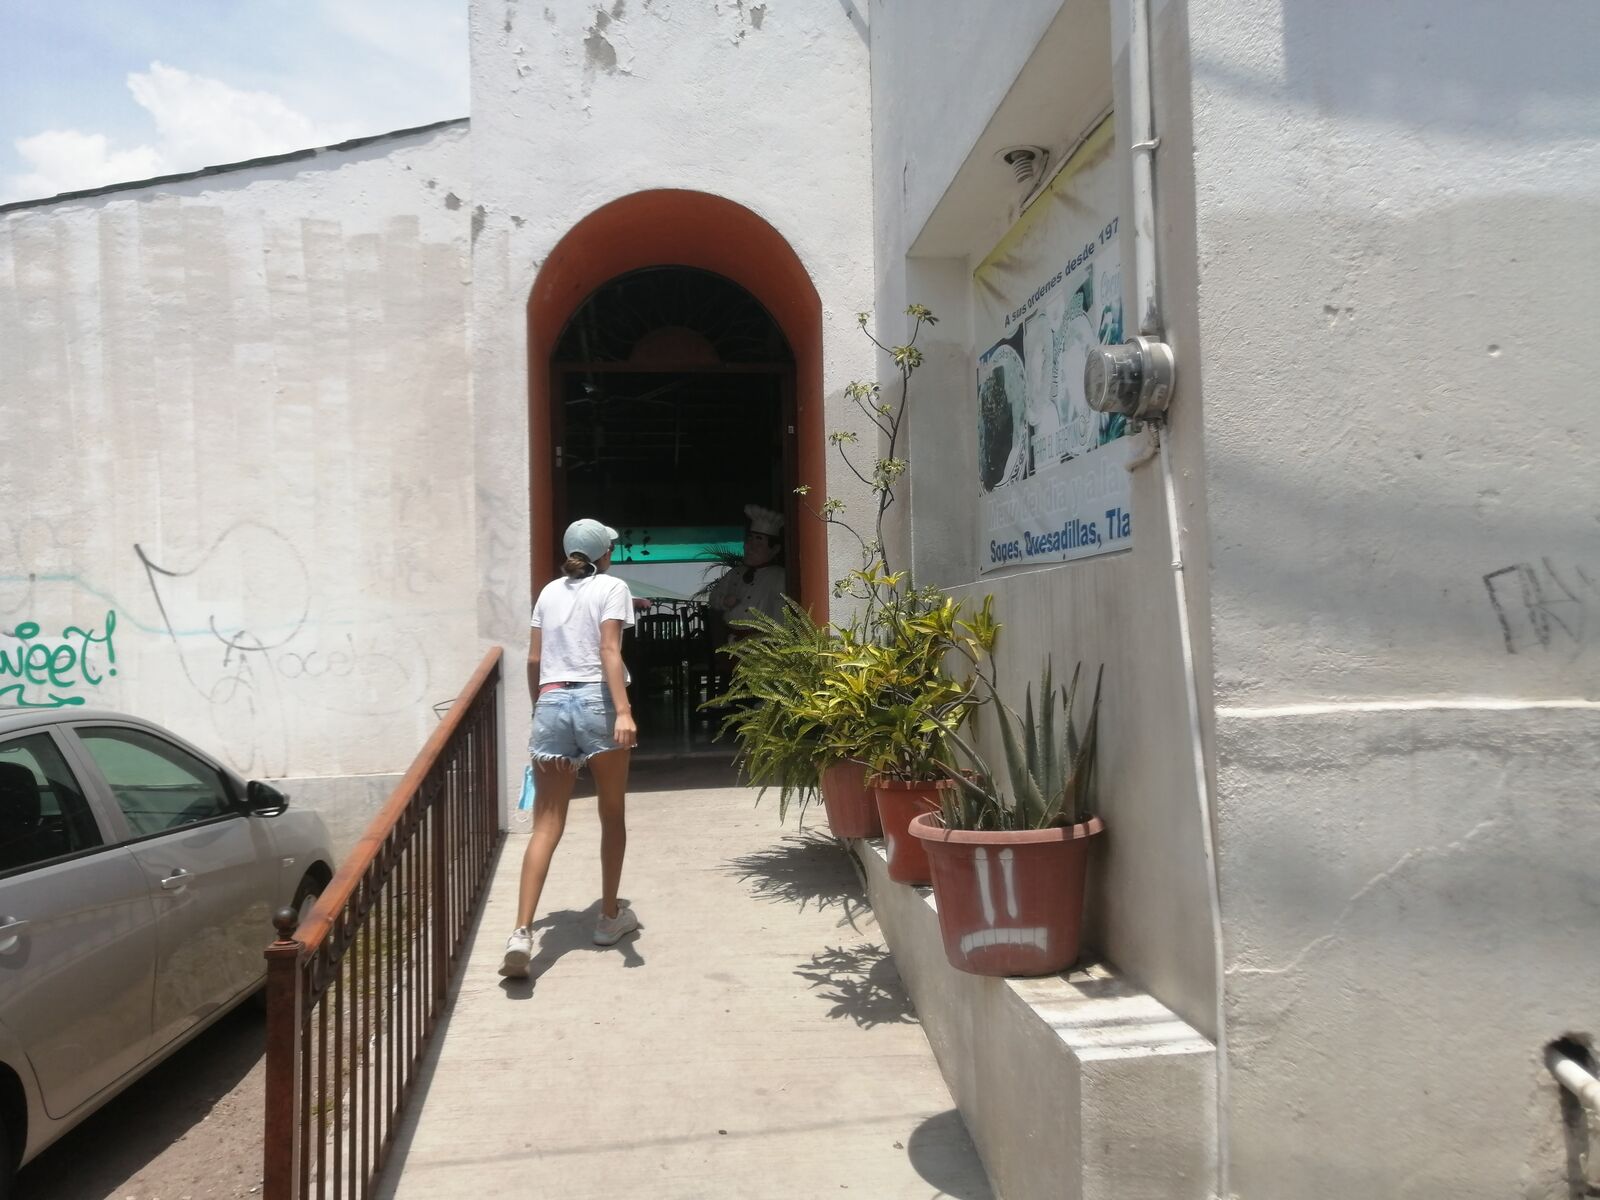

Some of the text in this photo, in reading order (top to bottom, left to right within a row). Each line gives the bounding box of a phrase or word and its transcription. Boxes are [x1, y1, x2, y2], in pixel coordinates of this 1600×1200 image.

[1004, 314, 1010, 328] A
[1012, 304, 1027, 322] sus
[1027, 271, 1063, 308] ordenes
[1065, 241, 1095, 276] desde
[990, 507, 1131, 564] Sopes, Quesadillas, Tla
